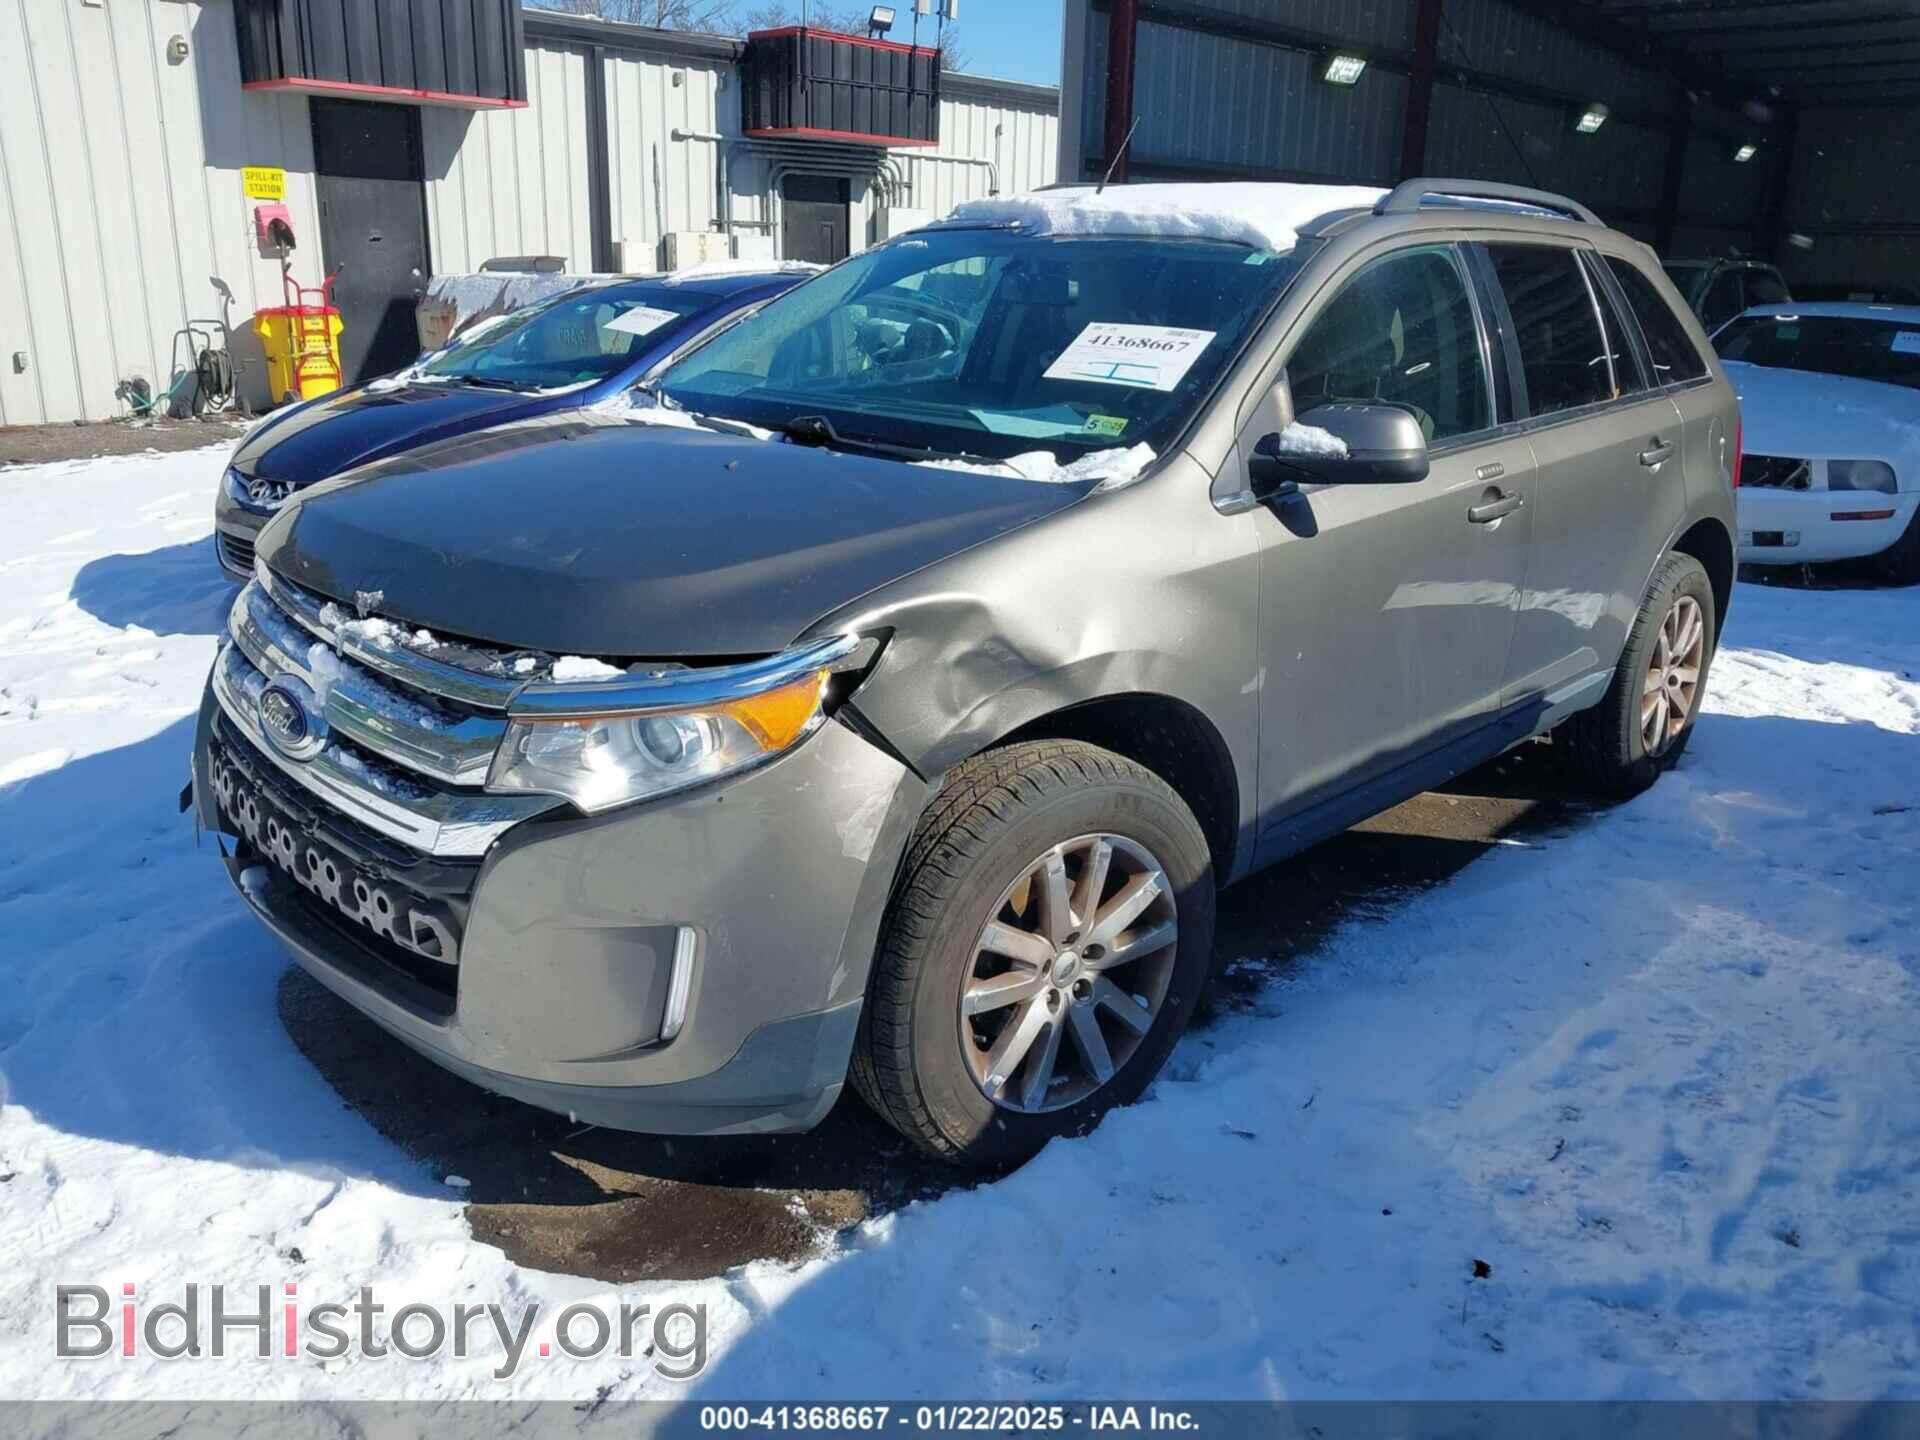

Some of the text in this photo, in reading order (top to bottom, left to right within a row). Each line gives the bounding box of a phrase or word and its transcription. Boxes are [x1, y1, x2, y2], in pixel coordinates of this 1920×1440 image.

[249, 183, 282, 193] STATION
[1088, 335, 1190, 352] 41368667
[1087, 419, 1100, 430] 5
[263, 693, 296, 735] Ford
